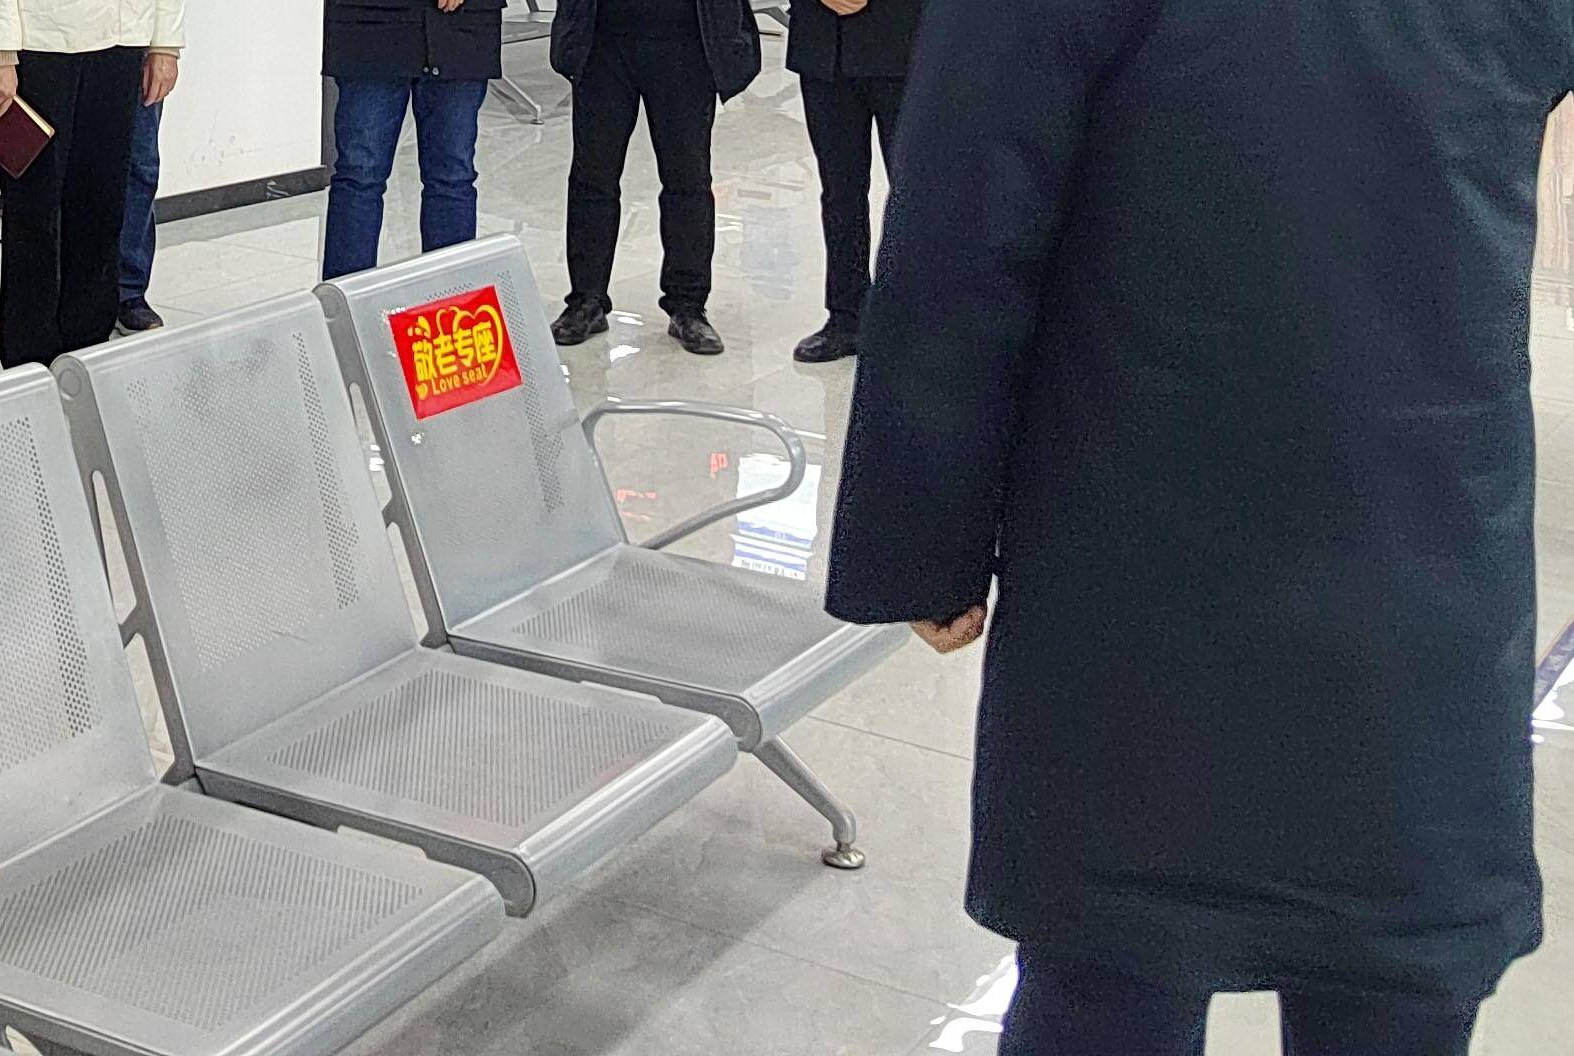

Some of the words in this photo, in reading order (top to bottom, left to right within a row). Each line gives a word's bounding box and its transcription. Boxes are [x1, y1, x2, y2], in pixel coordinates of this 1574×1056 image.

[407, 317, 497, 382] 敬老专座
[431, 375, 461, 396] Love
[463, 364, 488, 385] seat
